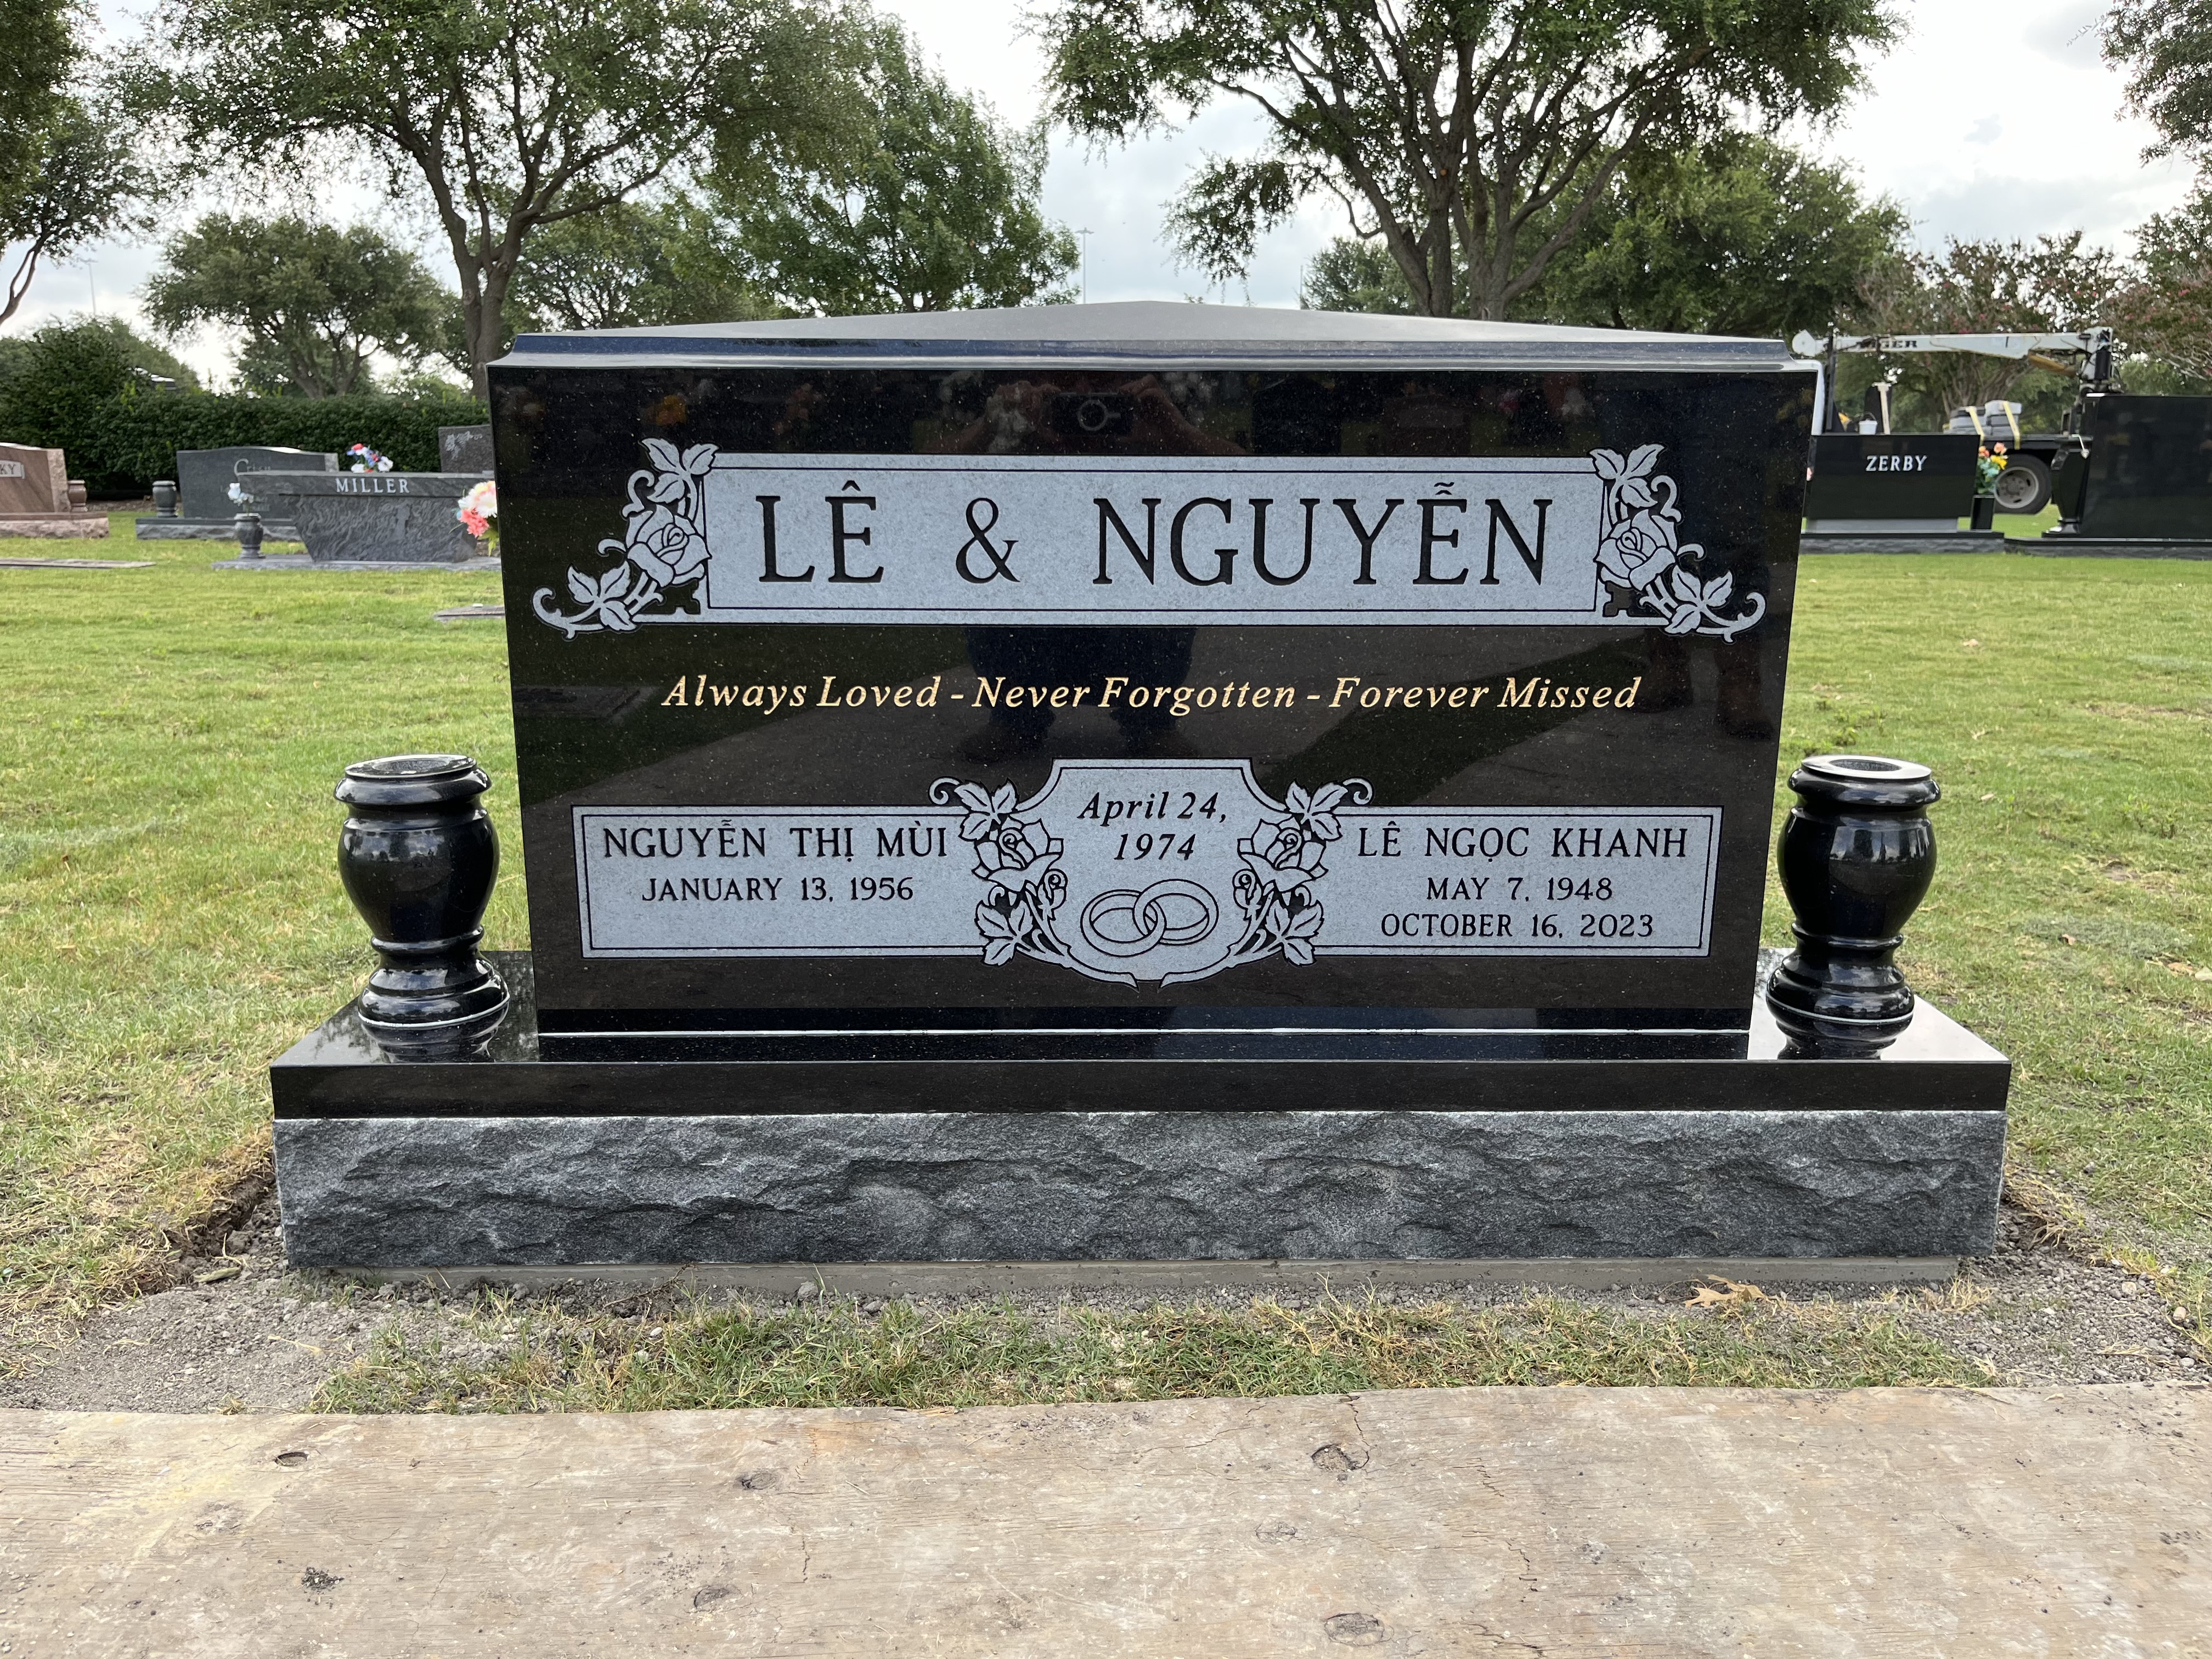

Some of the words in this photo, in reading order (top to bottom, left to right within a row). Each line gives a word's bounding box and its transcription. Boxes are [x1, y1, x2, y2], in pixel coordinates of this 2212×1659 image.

[1865, 455, 1928, 471] ZERBY
[335, 477, 410, 493] MILLER
[756, 480, 884, 583] LÊ
[956, 497, 1020, 584] &
[1093, 482, 1553, 586] NGUYỄN
[661, 674, 807, 715] Always
[816, 675, 941, 707] Loved
[972, 676, 1091, 708] Never
[1098, 676, 1295, 716] Forgotten
[1329, 676, 1489, 708] Forever
[1497, 676, 1642, 708] Missed
[1076, 791, 1169, 827] April
[1177, 792, 1226, 823] 24,
[603, 819, 766, 858] NGUYỄN
[789, 827, 854, 862] THỊ
[877, 820, 947, 857] MÙI
[1113, 833, 1197, 861] 1974
[1358, 820, 1401, 857] LÊ
[1425, 827, 1530, 862] NGỌC
[1551, 828, 1688, 858] KHANH
[642, 877, 783, 901] JANUARY
[801, 877, 833, 902] 13,
[850, 877, 913, 901] 1956
[1426, 877, 1490, 900] MAY
[1508, 877, 1529, 902] 7,
[1547, 877, 1612, 901] 1948
[1381, 913, 1513, 938] OCTOBER
[1531, 913, 1563, 939] 16,
[1579, 913, 1653, 938] 2023
